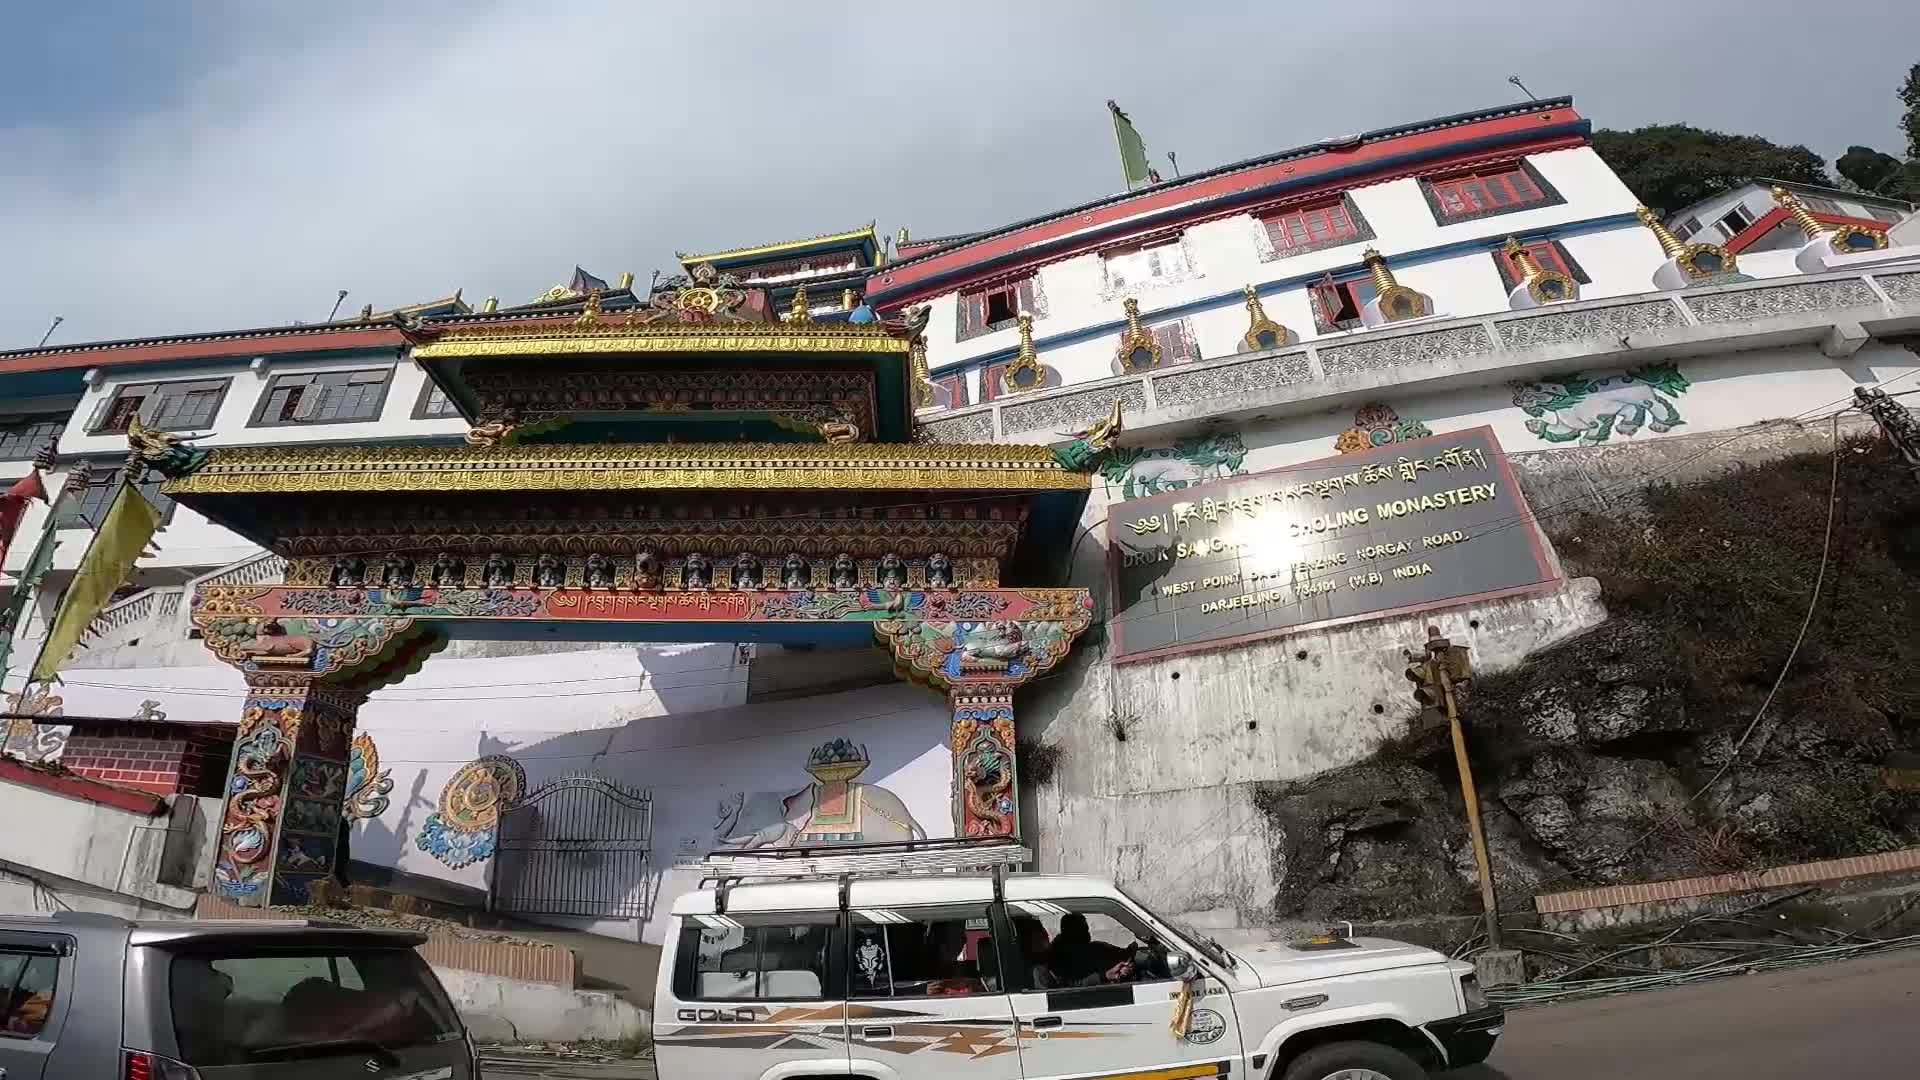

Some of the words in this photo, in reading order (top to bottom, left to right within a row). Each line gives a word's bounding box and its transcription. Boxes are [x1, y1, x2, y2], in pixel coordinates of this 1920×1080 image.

[1123, 547, 1168, 569] DRUK
[1377, 482, 1496, 520] MONASTERY
[1162, 580, 1196, 598] WEST
[1203, 572, 1241, 591] POINT
[1356, 540, 1414, 561] NORGAY
[1393, 562, 1433, 582] INDIA
[677, 1008, 755, 1022] GOLD
